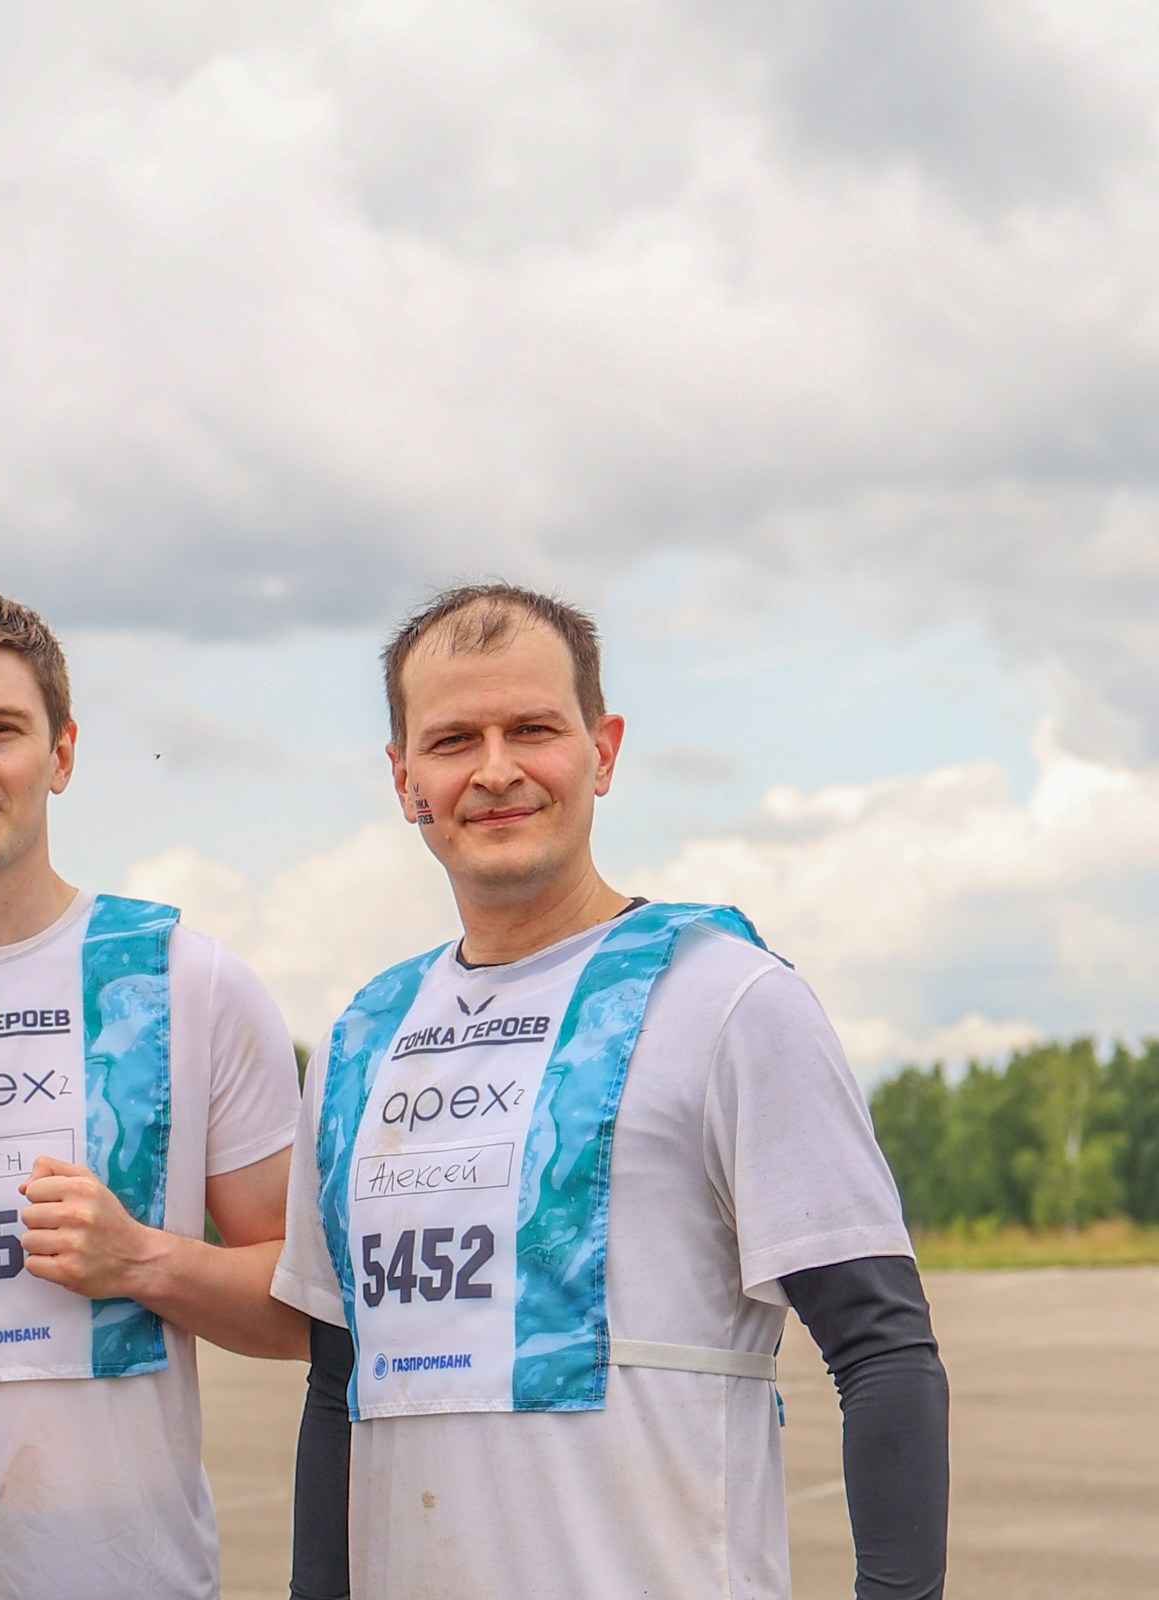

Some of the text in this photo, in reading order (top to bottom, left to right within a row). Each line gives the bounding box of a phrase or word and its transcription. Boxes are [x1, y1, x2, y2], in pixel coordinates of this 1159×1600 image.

[394, 1016, 551, 1054] ГОНКА ГЕРОЕВ
[368, 1148, 484, 1195] Алексей
[361, 1224, 495, 1309] 5452
[391, 1353, 472, 1374] ГАЗПРОМБАНК
